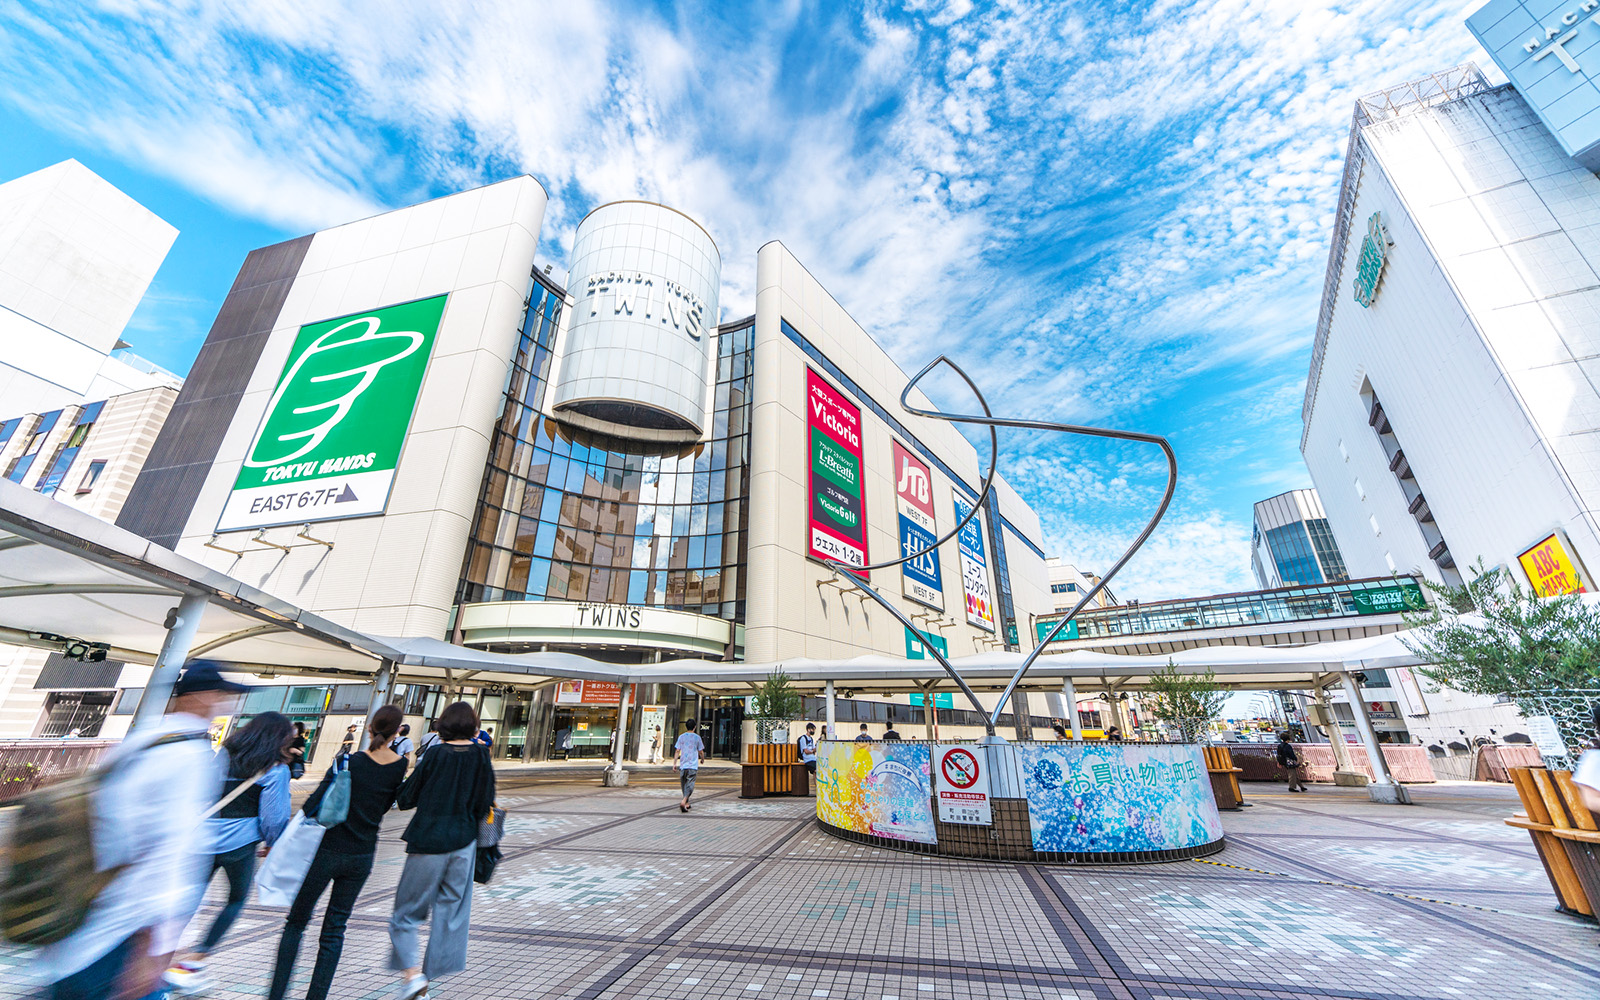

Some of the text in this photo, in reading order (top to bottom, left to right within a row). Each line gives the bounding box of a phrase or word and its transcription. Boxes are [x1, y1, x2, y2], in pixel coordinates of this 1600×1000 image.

[586, 285, 702, 342] TWINS
[811, 395, 859, 448] Victoria
[262, 452, 376, 482] TOKYU HANDS
[898, 455, 929, 505] JTB
[249, 493, 297, 514] EAST
[815, 536, 840, 555] ウエスト
[960, 530, 981, 551] イーオン
[967, 560, 983, 580] エース
[1530, 544, 1561, 579] ABC
[913, 584, 928, 599] WEST
[964, 574, 988, 598] コンタクト
[1542, 571, 1571, 597] MART
[1372, 591, 1402, 600] TOKYU
[577, 607, 641, 628] TWINS
